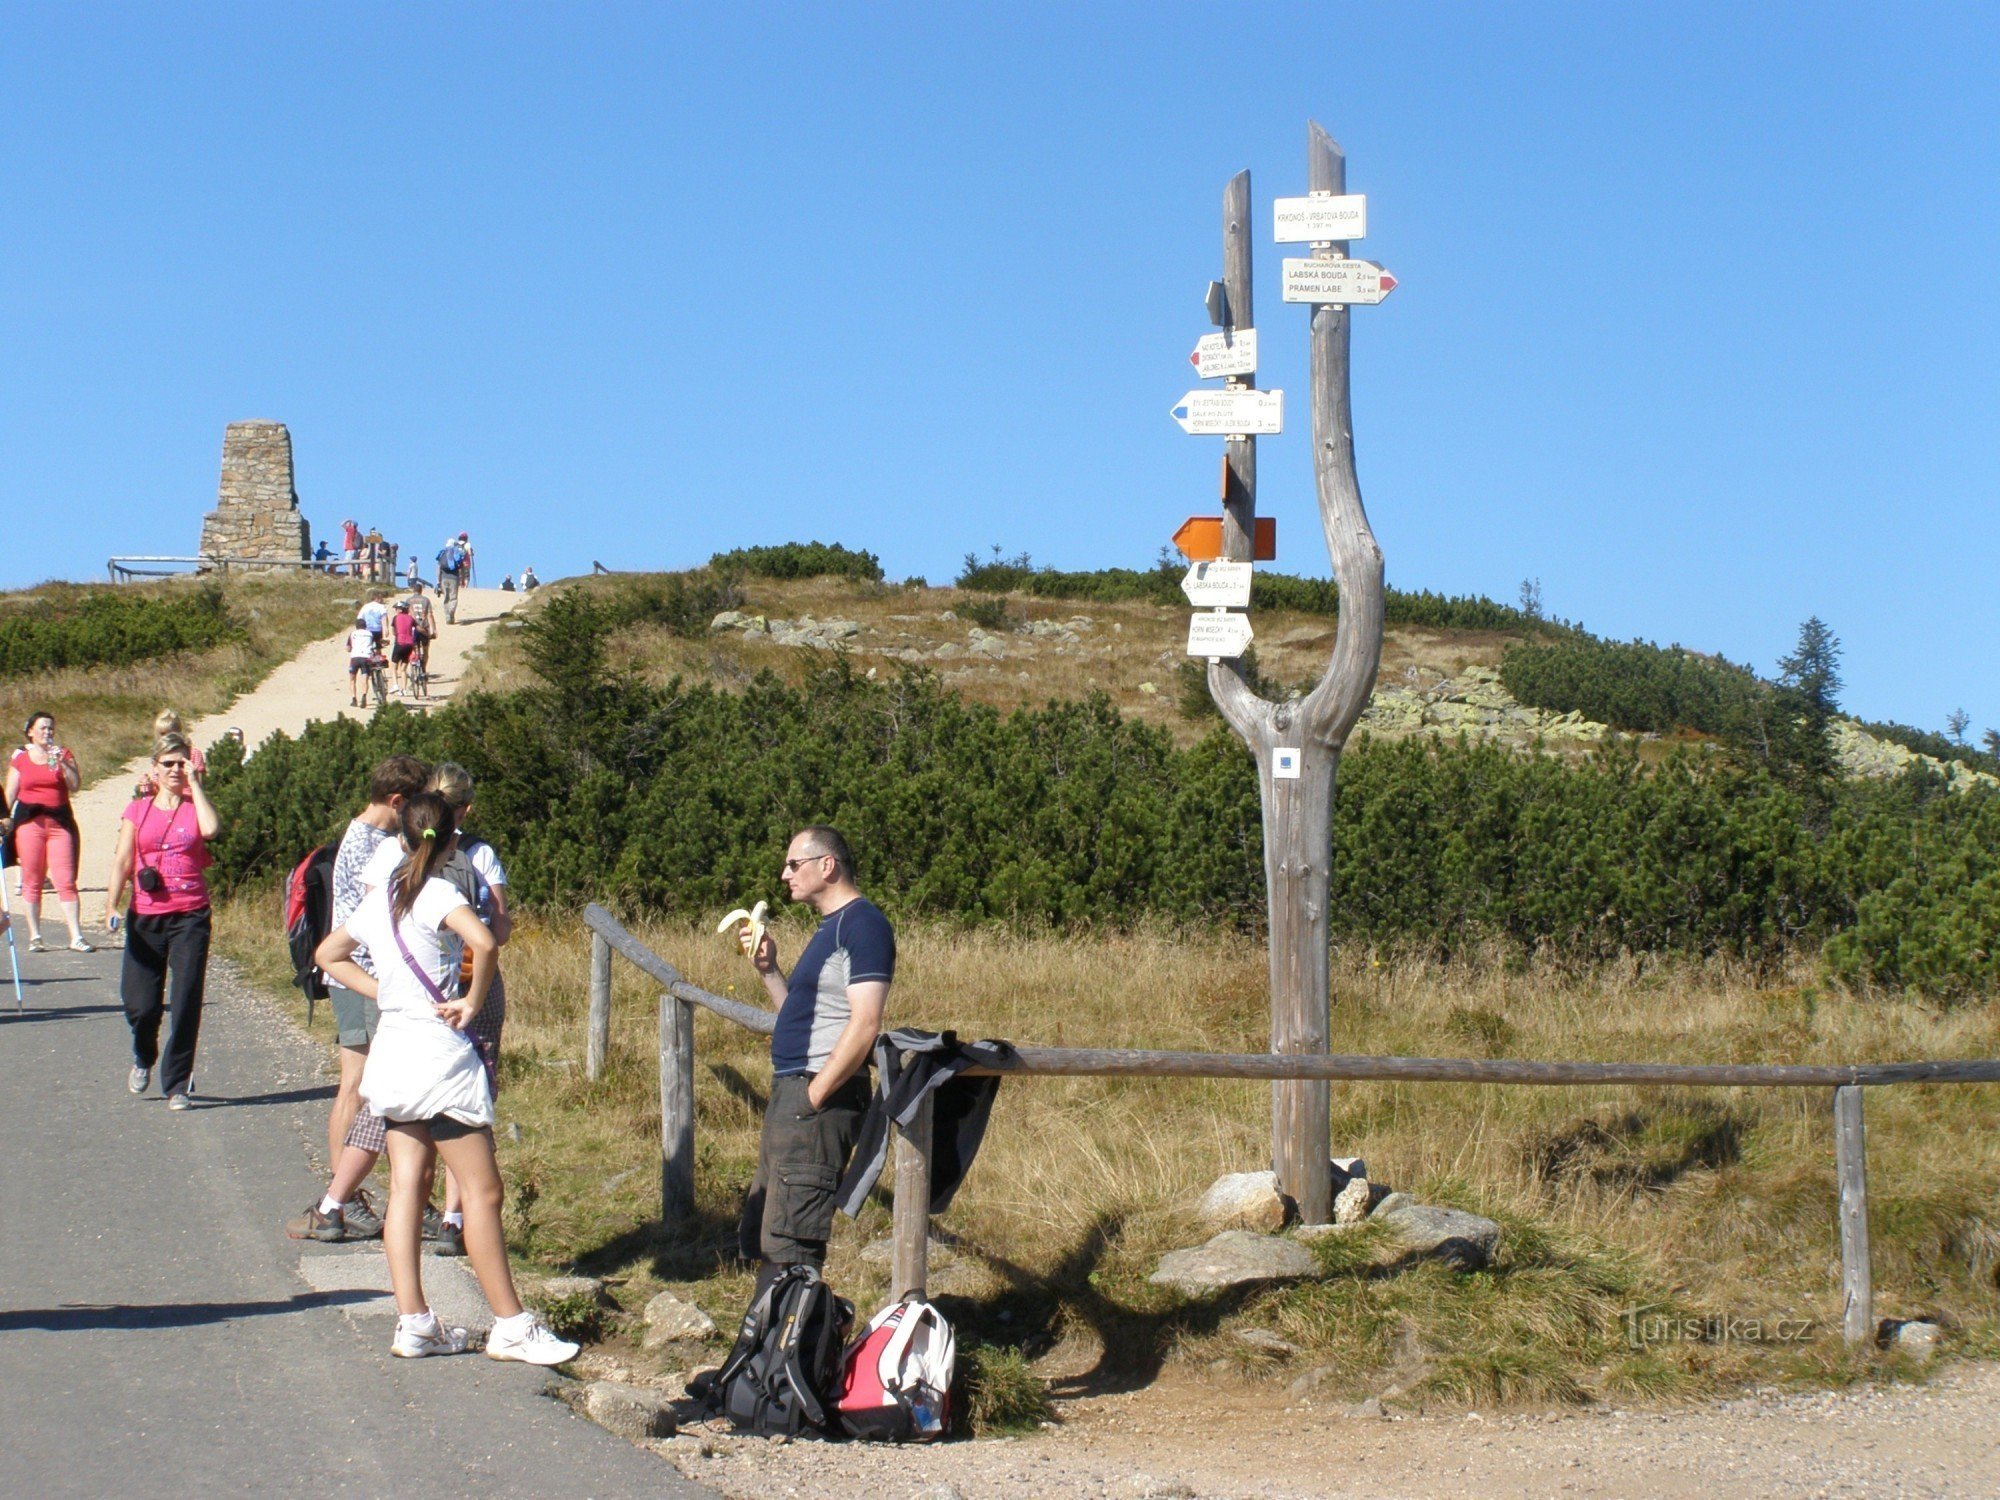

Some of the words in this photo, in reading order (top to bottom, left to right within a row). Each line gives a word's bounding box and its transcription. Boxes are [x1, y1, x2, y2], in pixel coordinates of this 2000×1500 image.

[1339, 211, 1359, 220] BOUDA
[1289, 269, 1319, 279] LABSKÁ
[1321, 271, 1347, 279] BOUDA
[1289, 284, 1321, 292] PRAMEN
[1322, 284, 1342, 292] LABE
